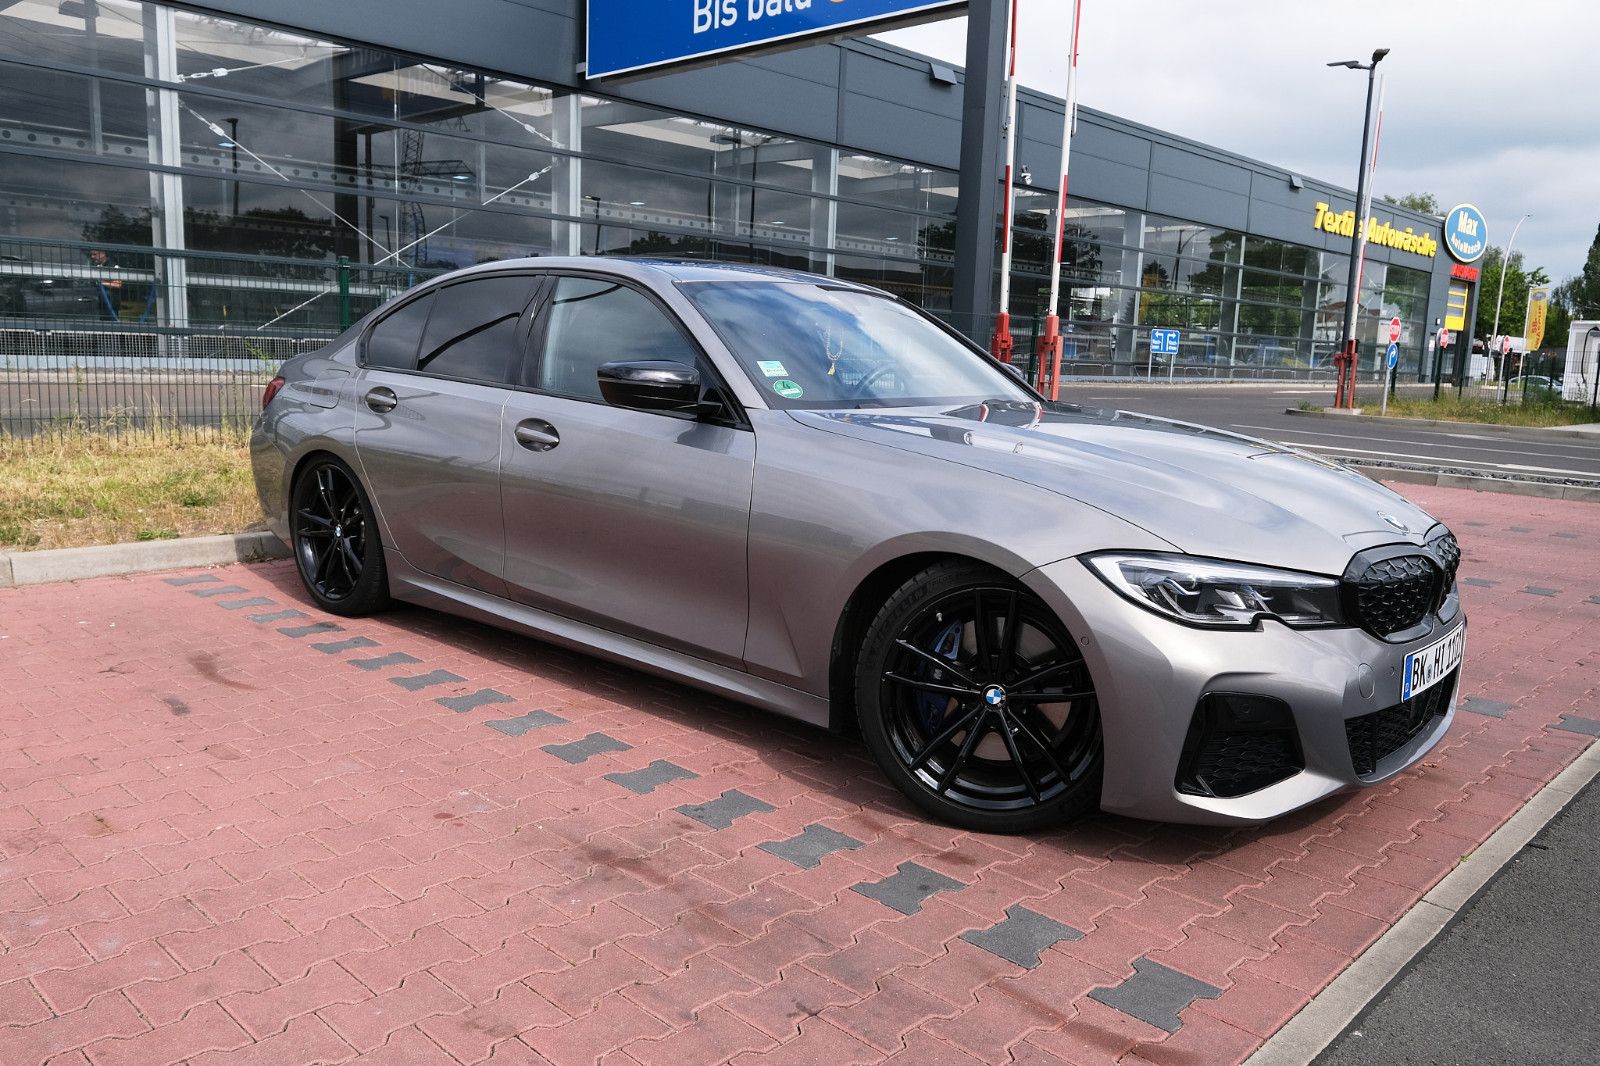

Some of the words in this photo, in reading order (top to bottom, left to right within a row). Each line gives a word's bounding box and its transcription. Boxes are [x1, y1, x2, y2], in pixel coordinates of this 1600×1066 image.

[693, 0, 738, 34] Bis
[1367, 219, 1437, 257] Autowäsche
[1457, 210, 1479, 237] Max
[1412, 653, 1428, 691] BK
[1433, 643, 1446, 679] HI
